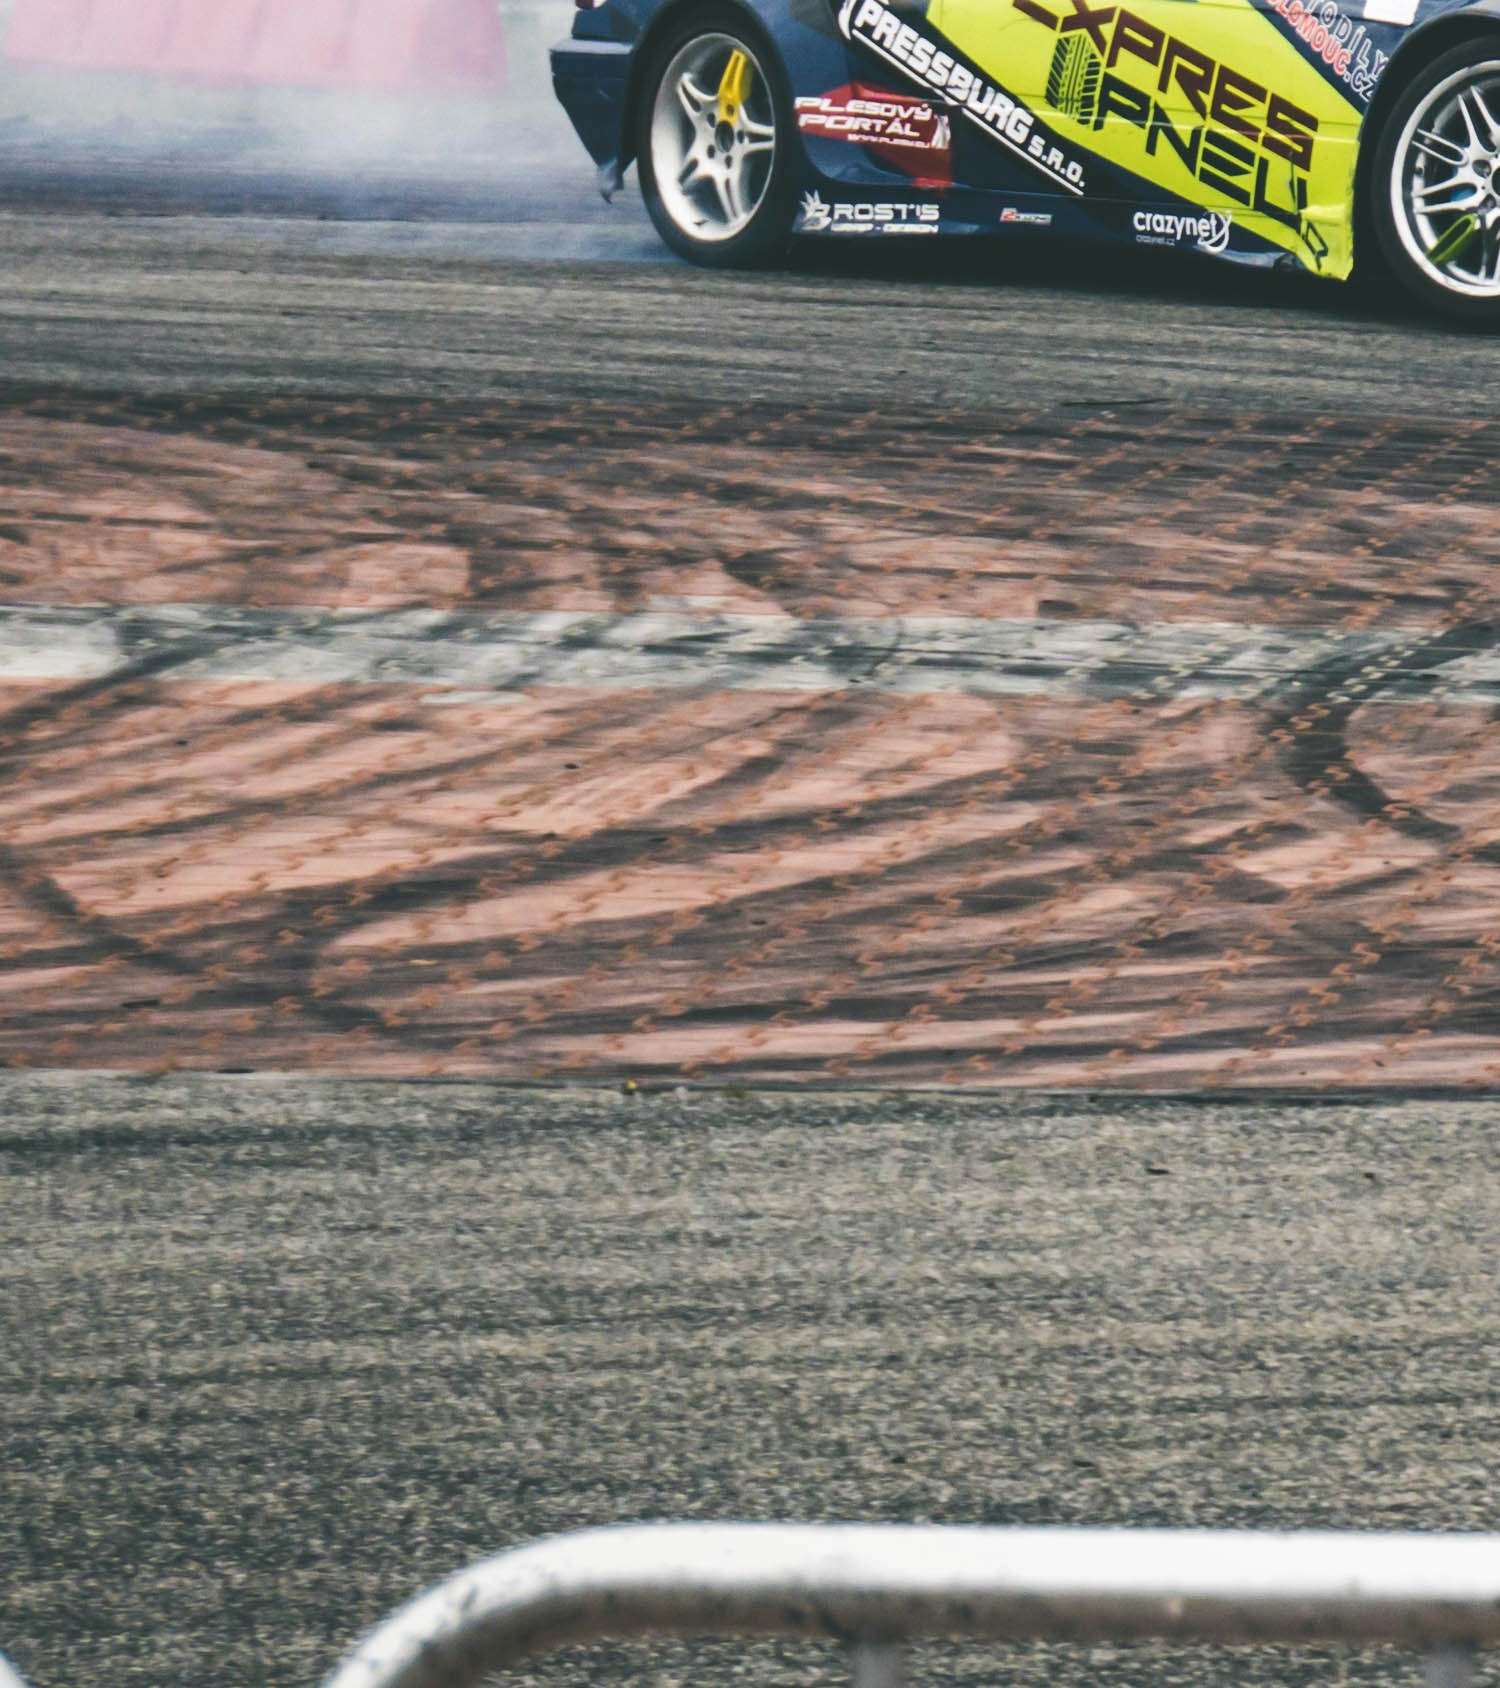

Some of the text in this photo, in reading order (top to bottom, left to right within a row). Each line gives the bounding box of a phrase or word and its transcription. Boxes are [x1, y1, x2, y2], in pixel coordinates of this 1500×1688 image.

[793, 96, 933, 121] PLESOVÝ
[798, 113, 920, 137] PORTÁL
[1093, 70, 1309, 235] PNEU
[1133, 211, 1219, 241] crazynet
